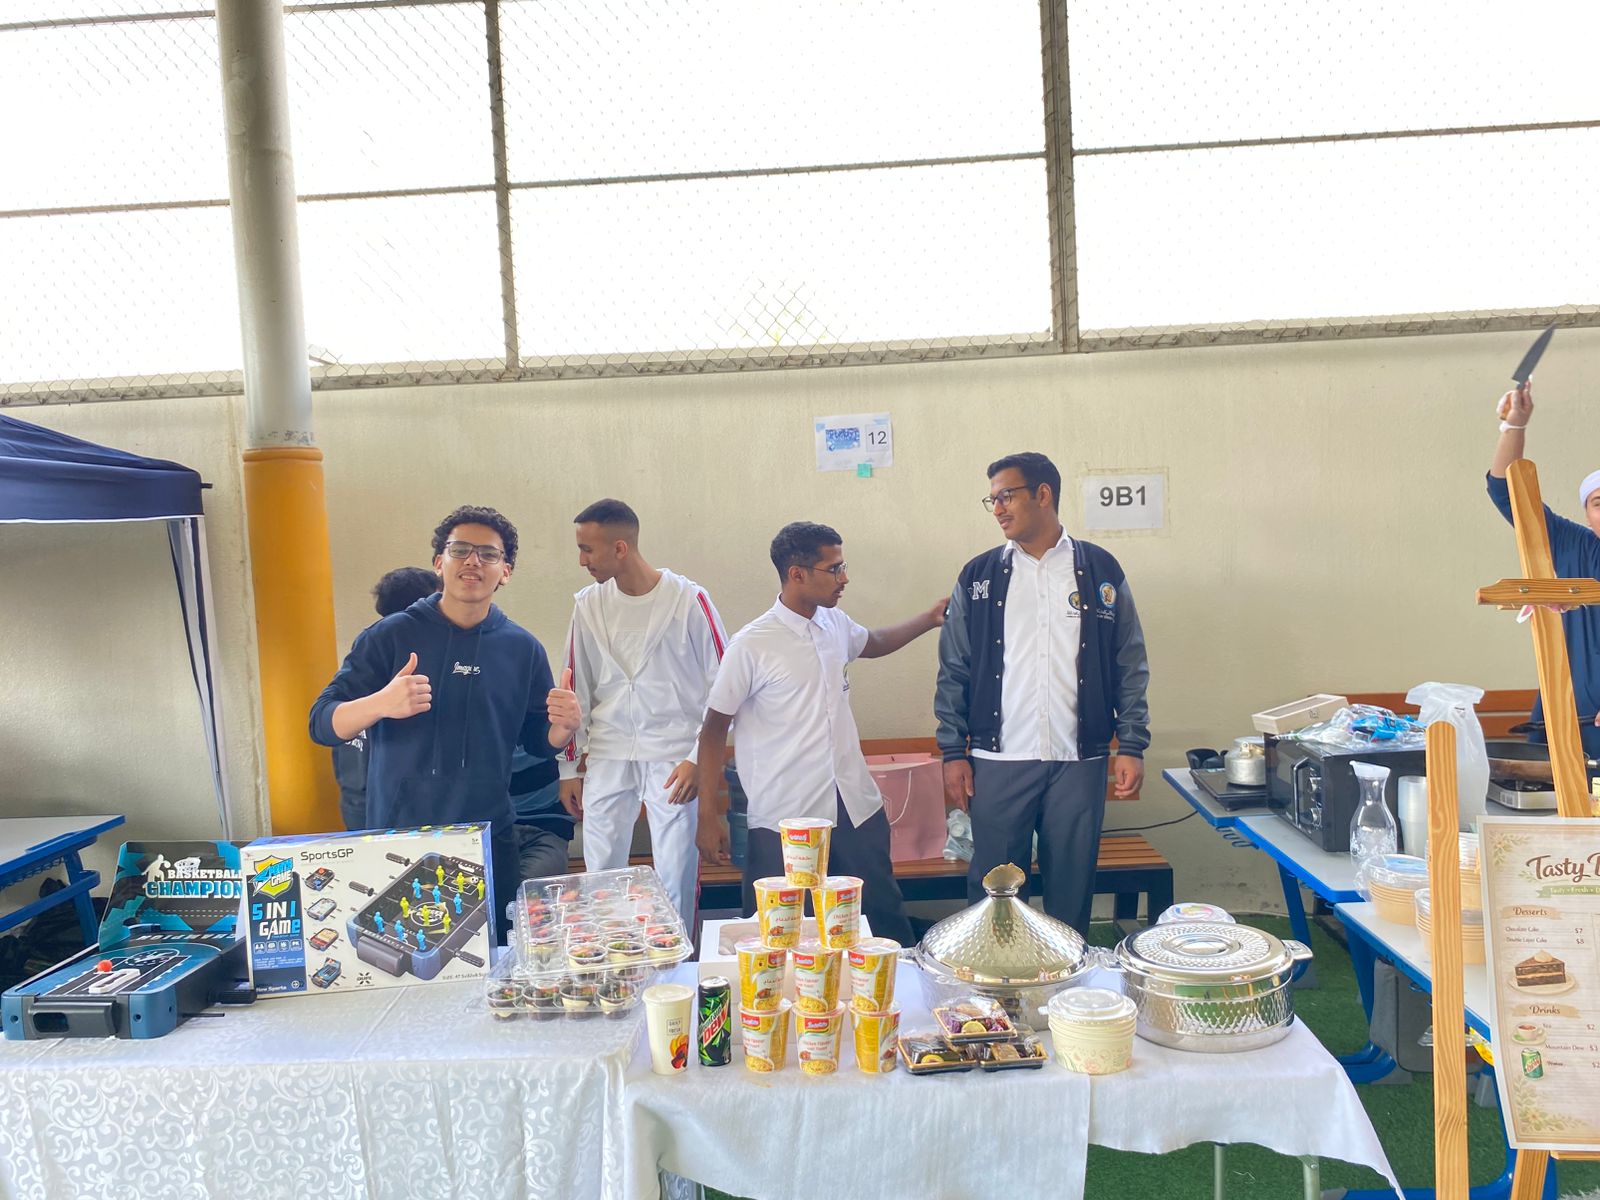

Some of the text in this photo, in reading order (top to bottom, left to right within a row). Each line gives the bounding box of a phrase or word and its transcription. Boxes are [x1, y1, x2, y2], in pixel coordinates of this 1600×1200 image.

[868, 430, 887, 445] 12
[1099, 485, 1146, 507] 9B1
[971, 579, 990, 600] M
[300, 847, 354, 863] SportsGP
[1525, 854, 1592, 883] Tasty
[145, 880, 242, 899] CHAMPION
[252, 902, 263, 921] 5
[266, 900, 287, 919] IN
[1512, 906, 1548, 916] Desserts
[1529, 1005, 1561, 1015] Drinks
